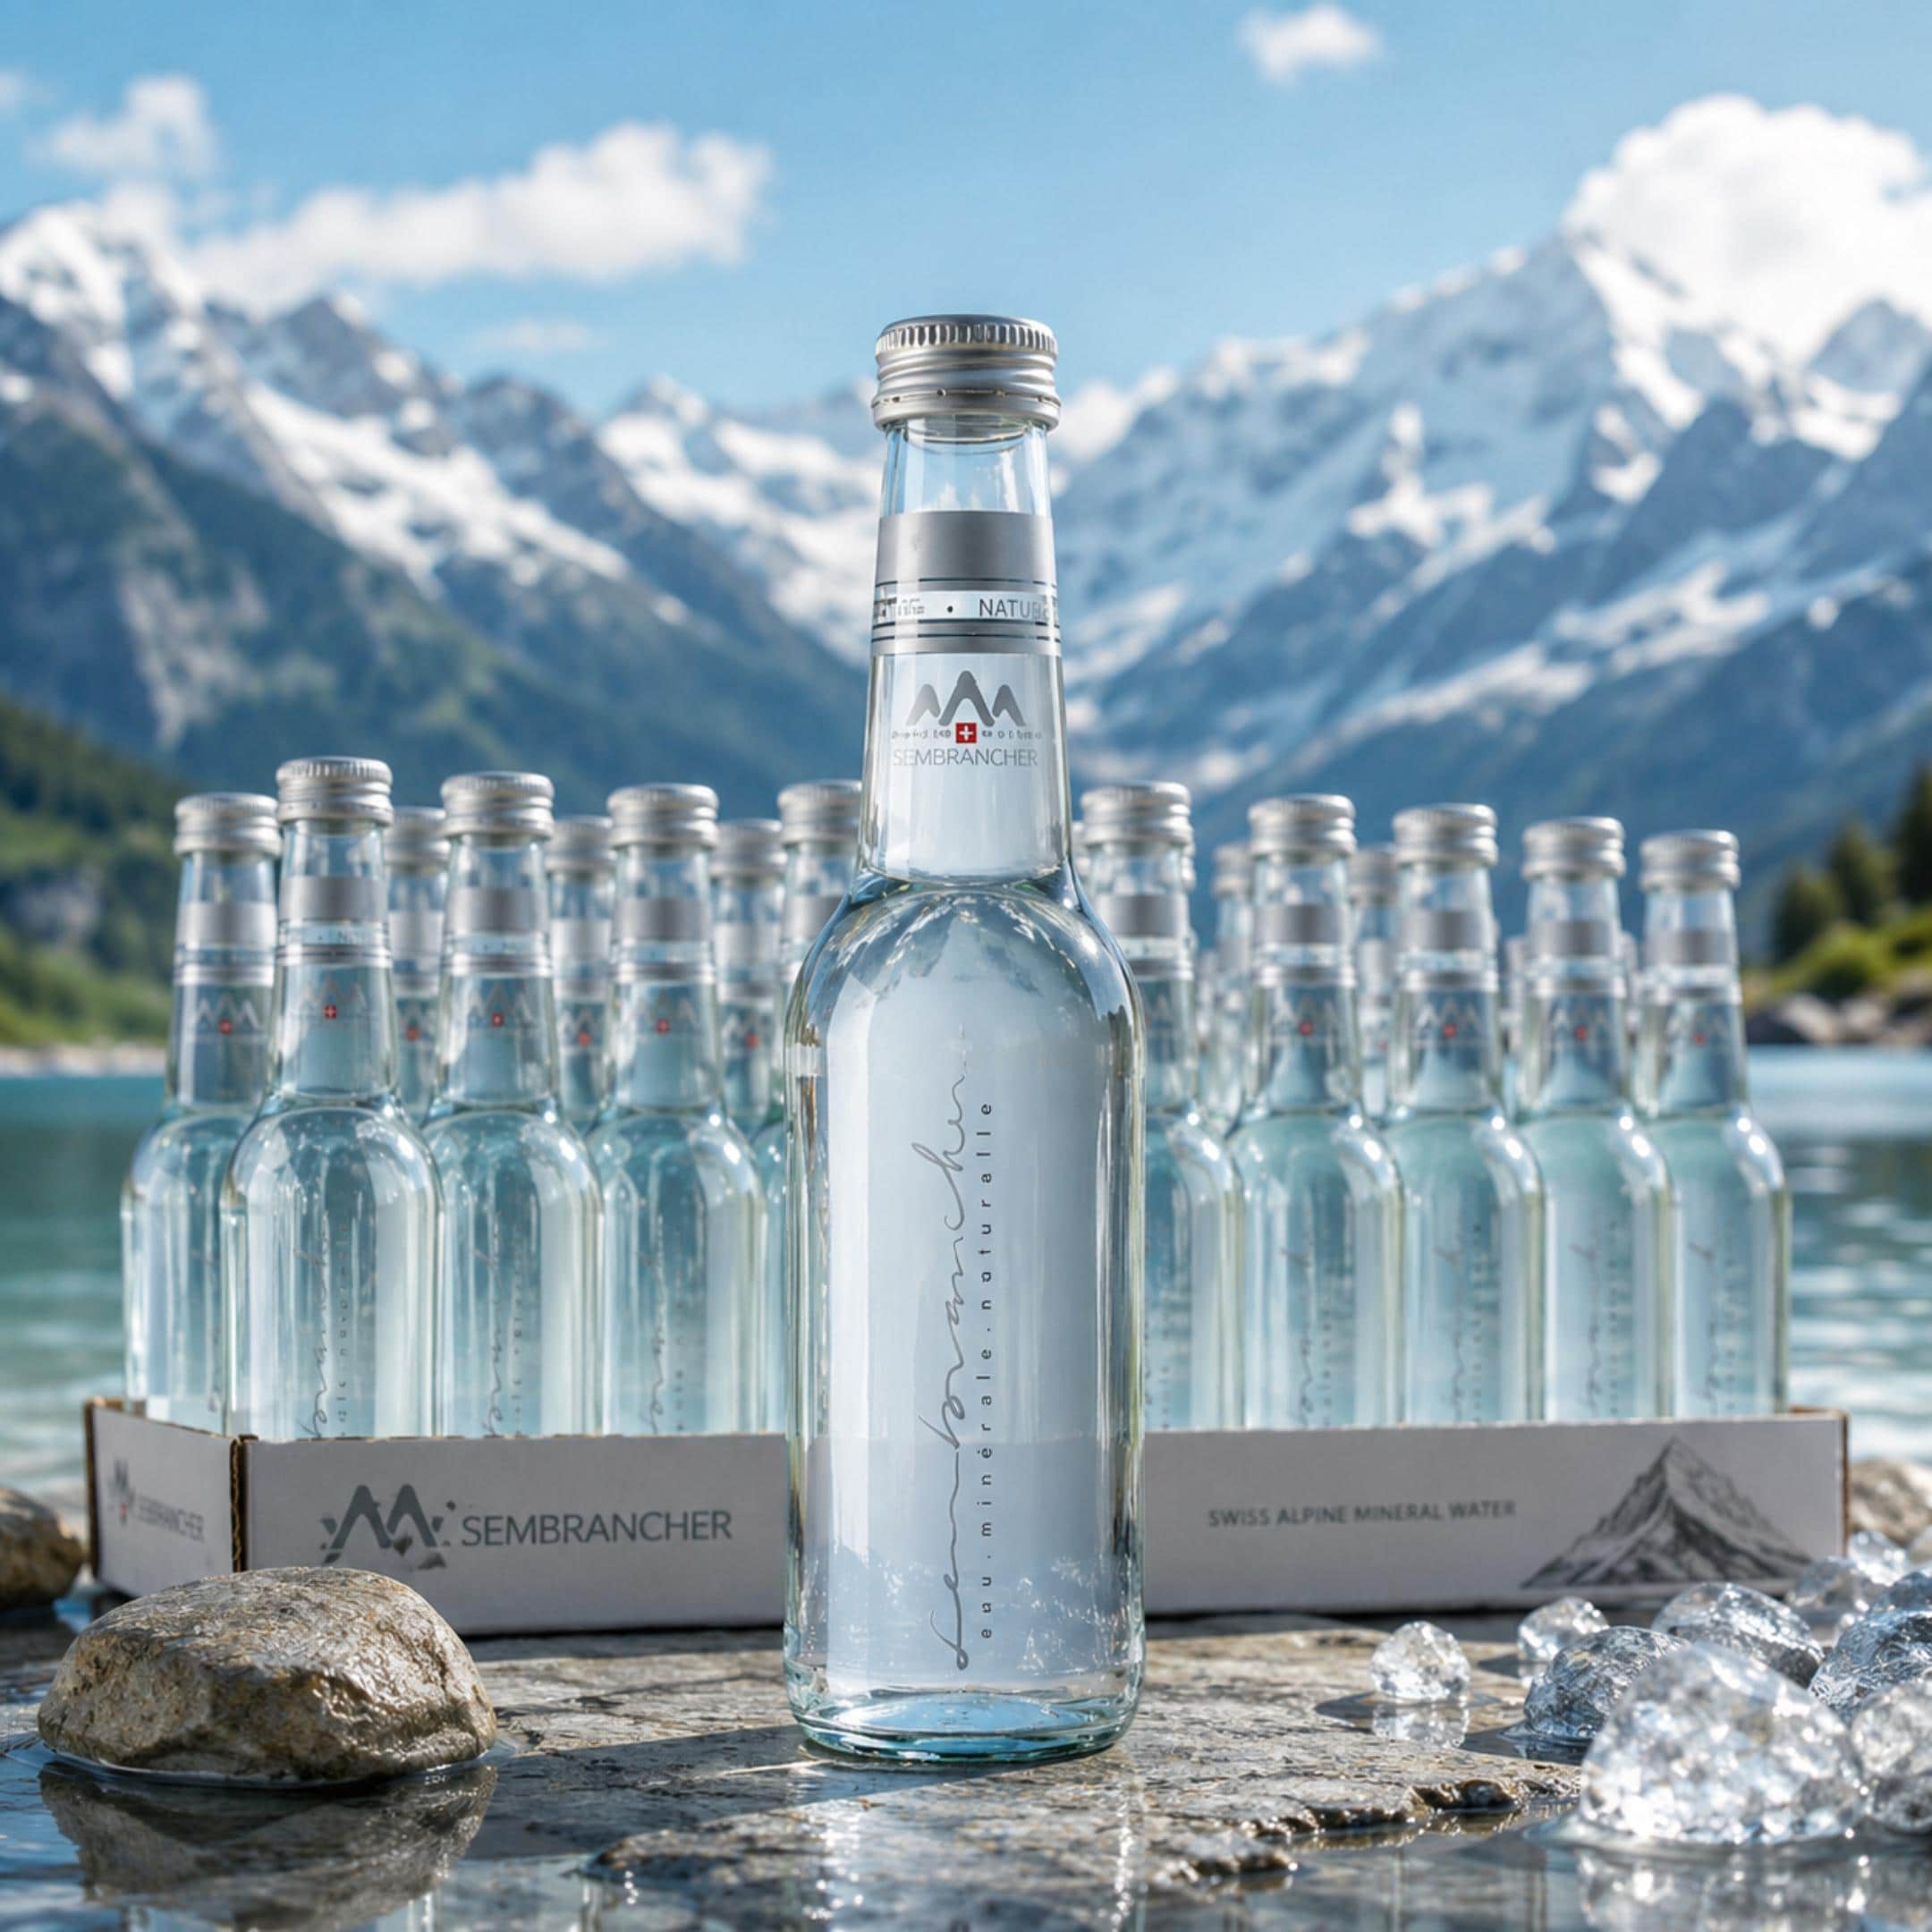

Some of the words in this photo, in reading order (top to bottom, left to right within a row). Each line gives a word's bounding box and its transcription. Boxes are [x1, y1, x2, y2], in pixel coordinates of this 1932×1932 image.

[893, 748, 1038, 767] SEMBRANCHER
[461, 1509, 733, 1546] SEMBRANCHER
[1208, 1507, 1270, 1528] SWISS
[1275, 1504, 1348, 1525] ALPINE
[1352, 1502, 1443, 1522] MINERAL
[1447, 1499, 1517, 1519] WATER
